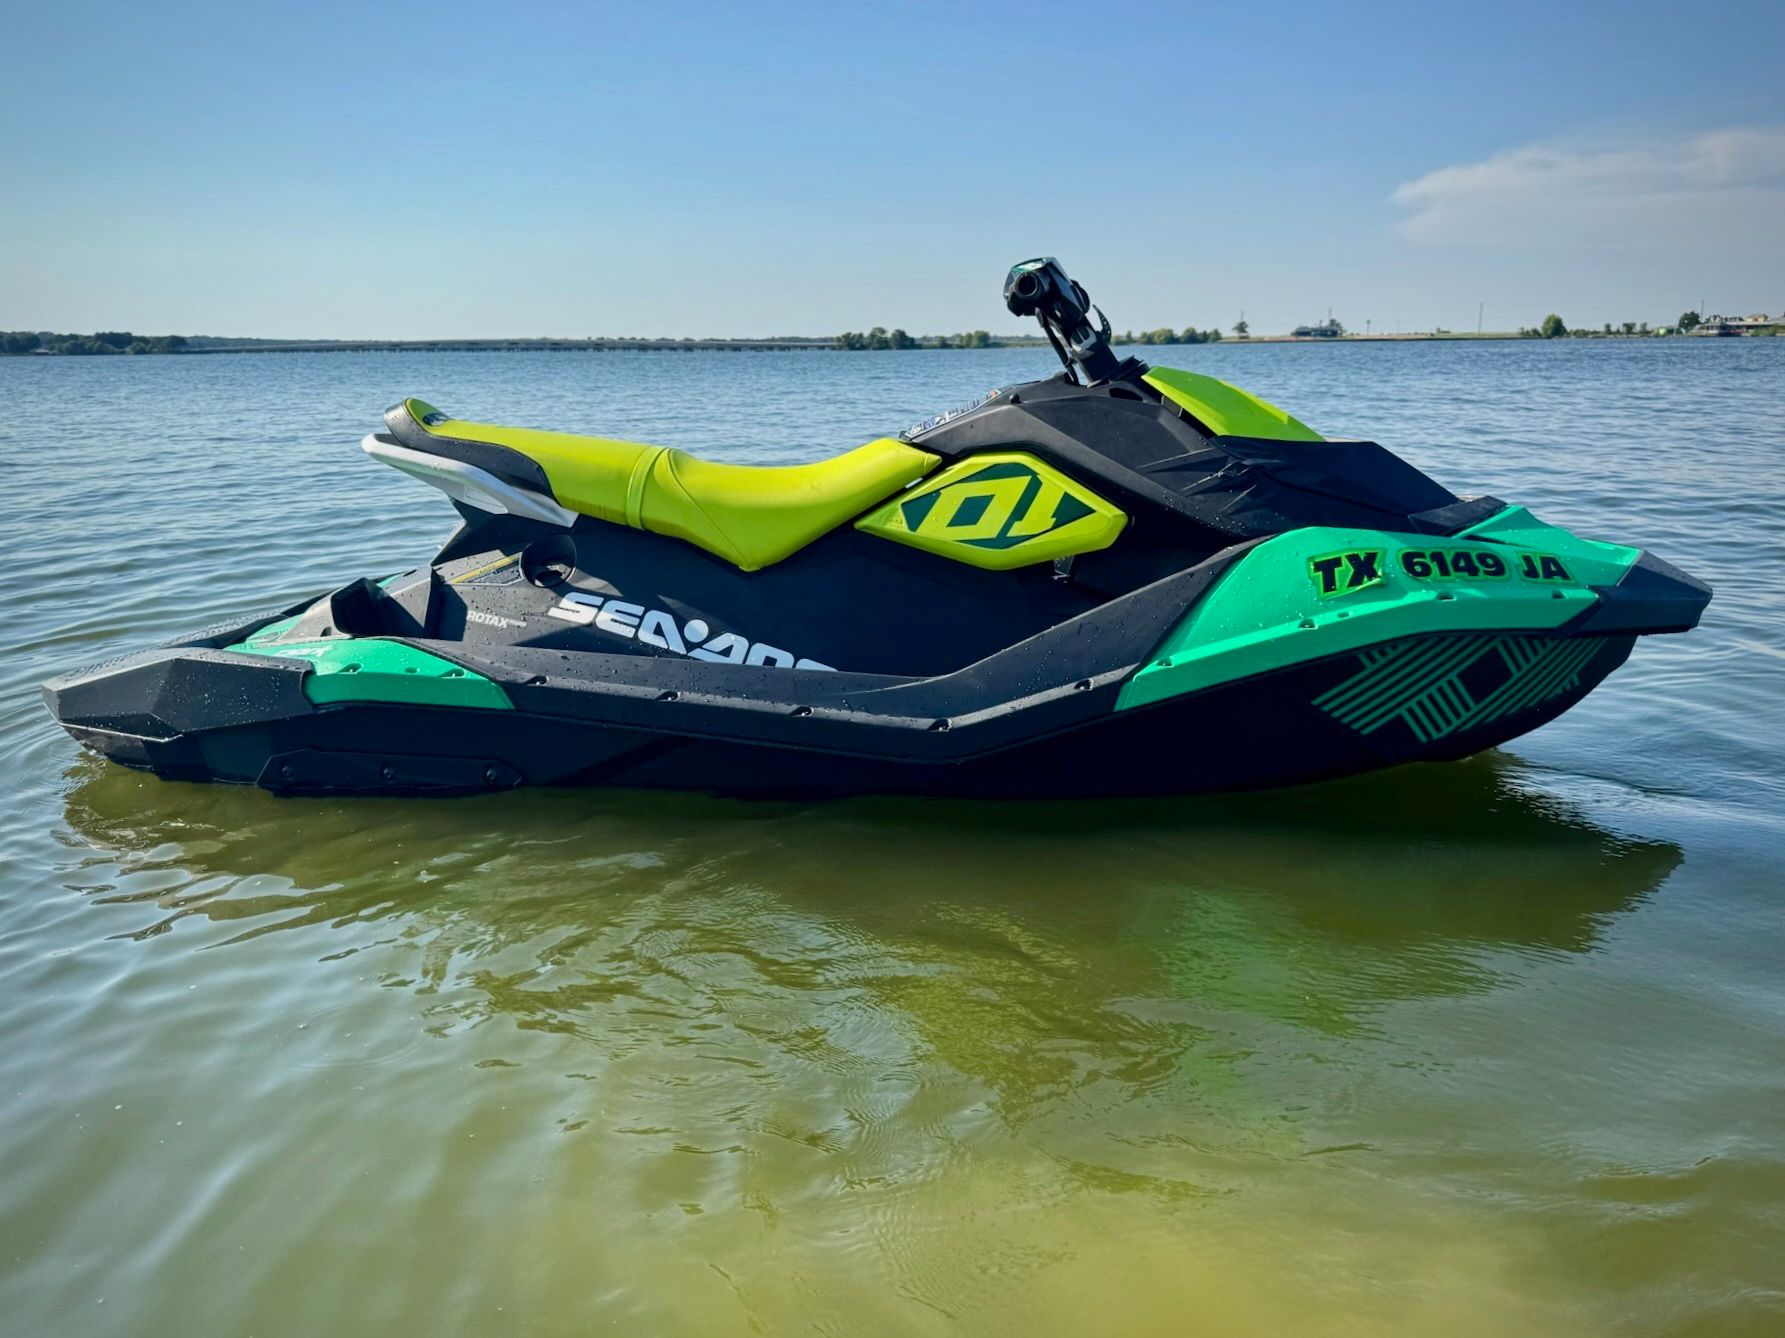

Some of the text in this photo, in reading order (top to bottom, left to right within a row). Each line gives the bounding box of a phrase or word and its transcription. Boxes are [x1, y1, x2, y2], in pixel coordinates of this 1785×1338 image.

[1313, 551, 1572, 593] TX 6149 JA
[466, 610, 509, 629] ROTAX
